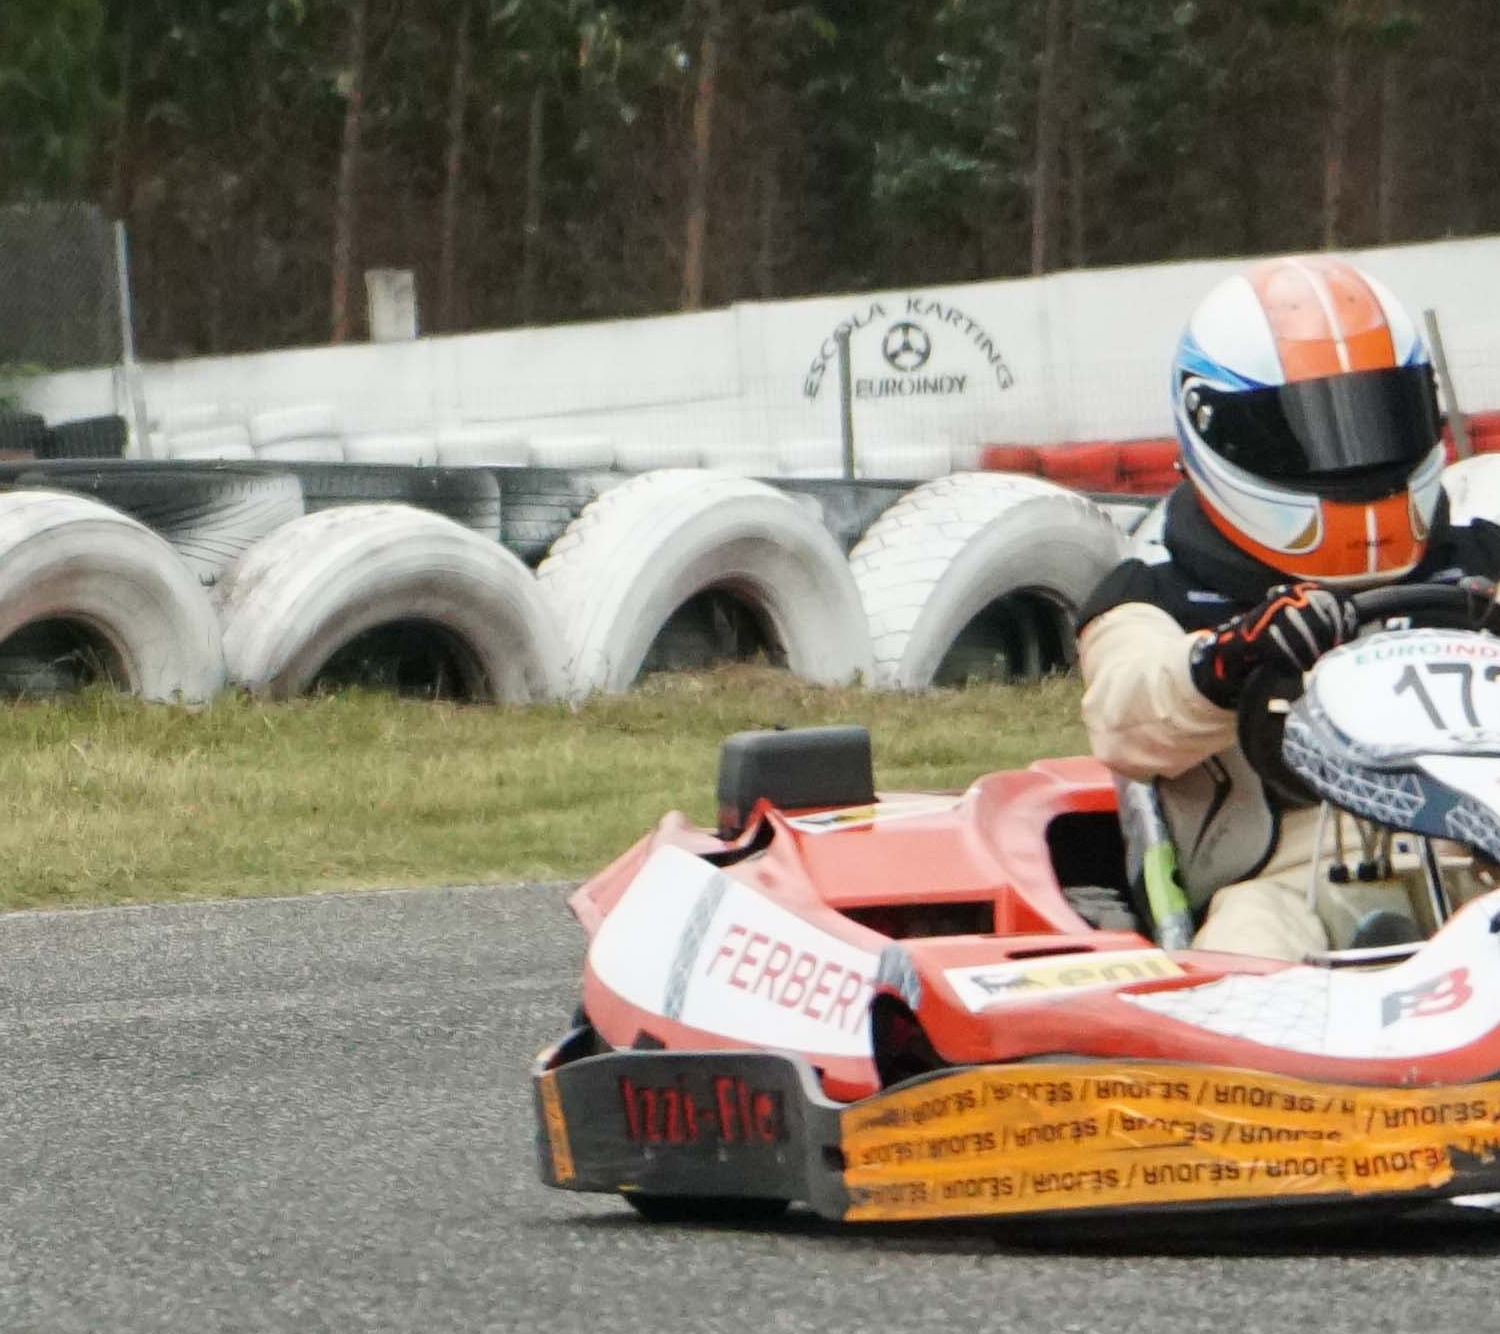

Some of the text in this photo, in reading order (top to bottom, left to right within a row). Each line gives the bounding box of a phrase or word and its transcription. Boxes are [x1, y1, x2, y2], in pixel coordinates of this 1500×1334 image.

[804, 297, 1014, 399] ESCOLA KARTING
[855, 375, 967, 398] EUROINDY
[1057, 959, 1165, 987] eni
